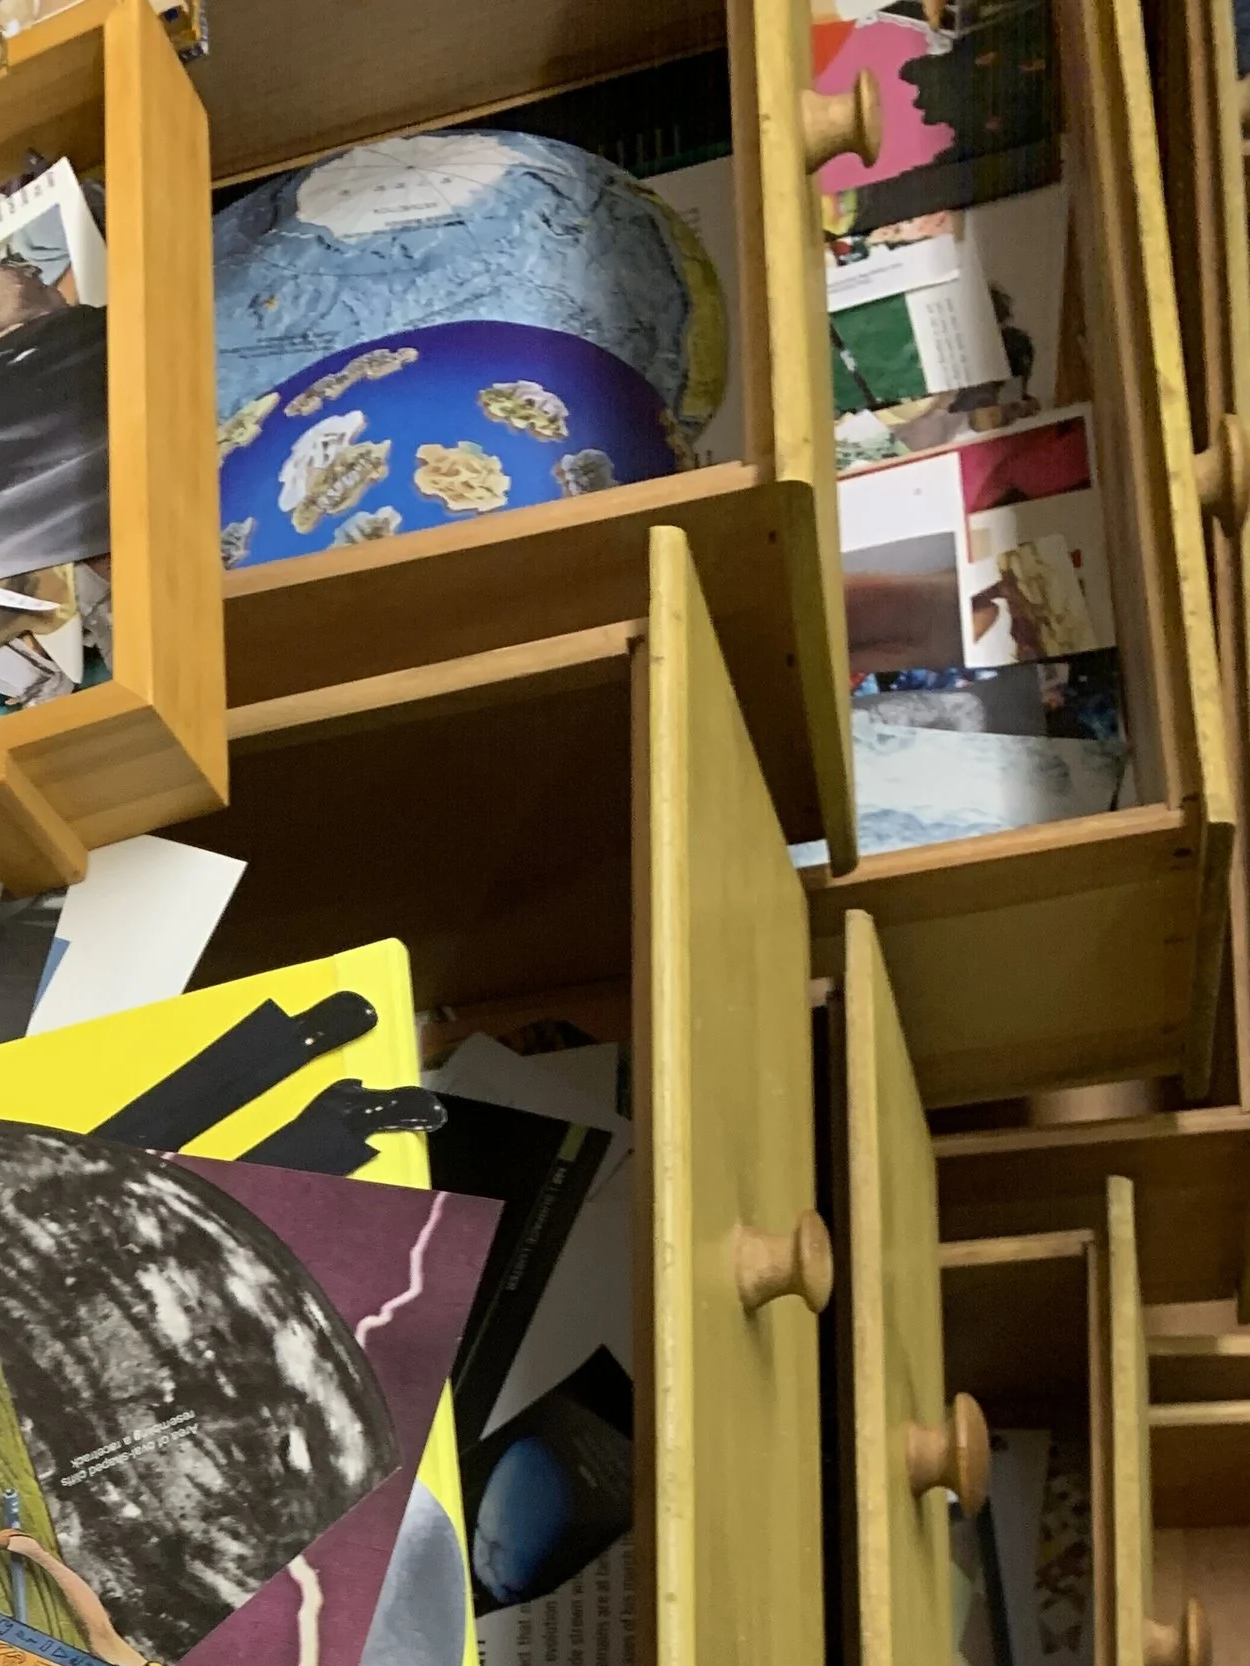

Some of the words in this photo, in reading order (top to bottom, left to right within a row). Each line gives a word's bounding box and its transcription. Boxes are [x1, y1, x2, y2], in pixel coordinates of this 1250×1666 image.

[133, 1410, 196, 1440] resembling
[170, 1423, 198, 1440] Area
[70, 1441, 122, 1468] racetrack
[158, 1436, 168, 1448] of
[88, 1441, 154, 1476] oval-shaped
[516, 1620, 531, 1645] that
[543, 1601, 558, 1662] evolution
